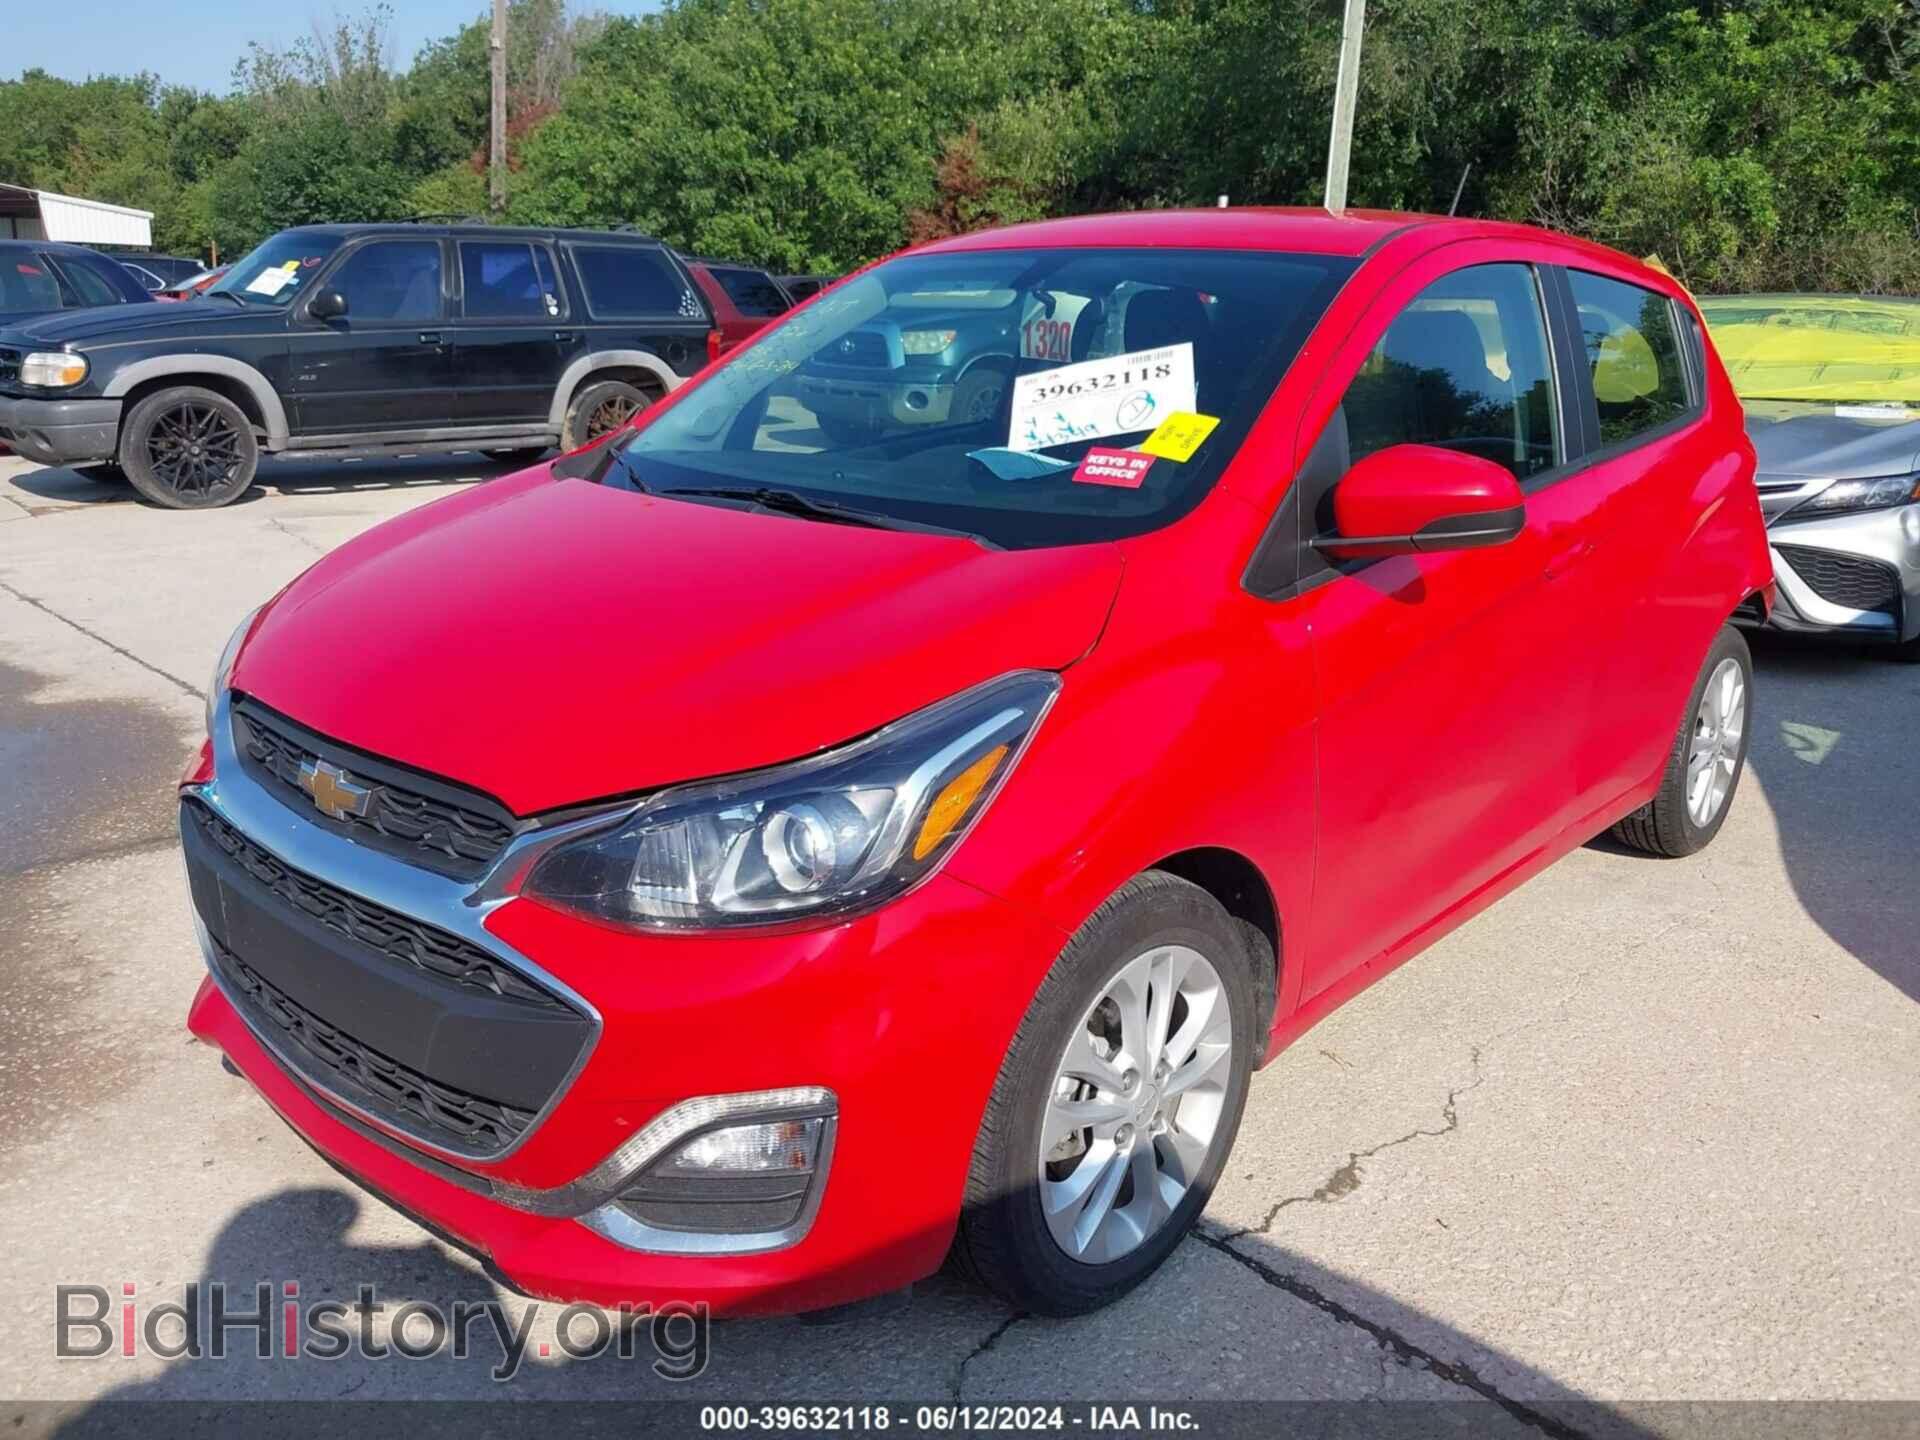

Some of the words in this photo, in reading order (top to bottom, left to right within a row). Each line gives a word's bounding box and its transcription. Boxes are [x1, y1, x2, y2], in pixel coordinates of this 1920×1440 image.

[1022, 319, 1072, 361] 1320
[1031, 363, 1172, 403] 39632118
[1084, 466, 1138, 480] OFFICE
[1086, 455, 1127, 467] KEYS
[1129, 458, 1148, 470] IN
